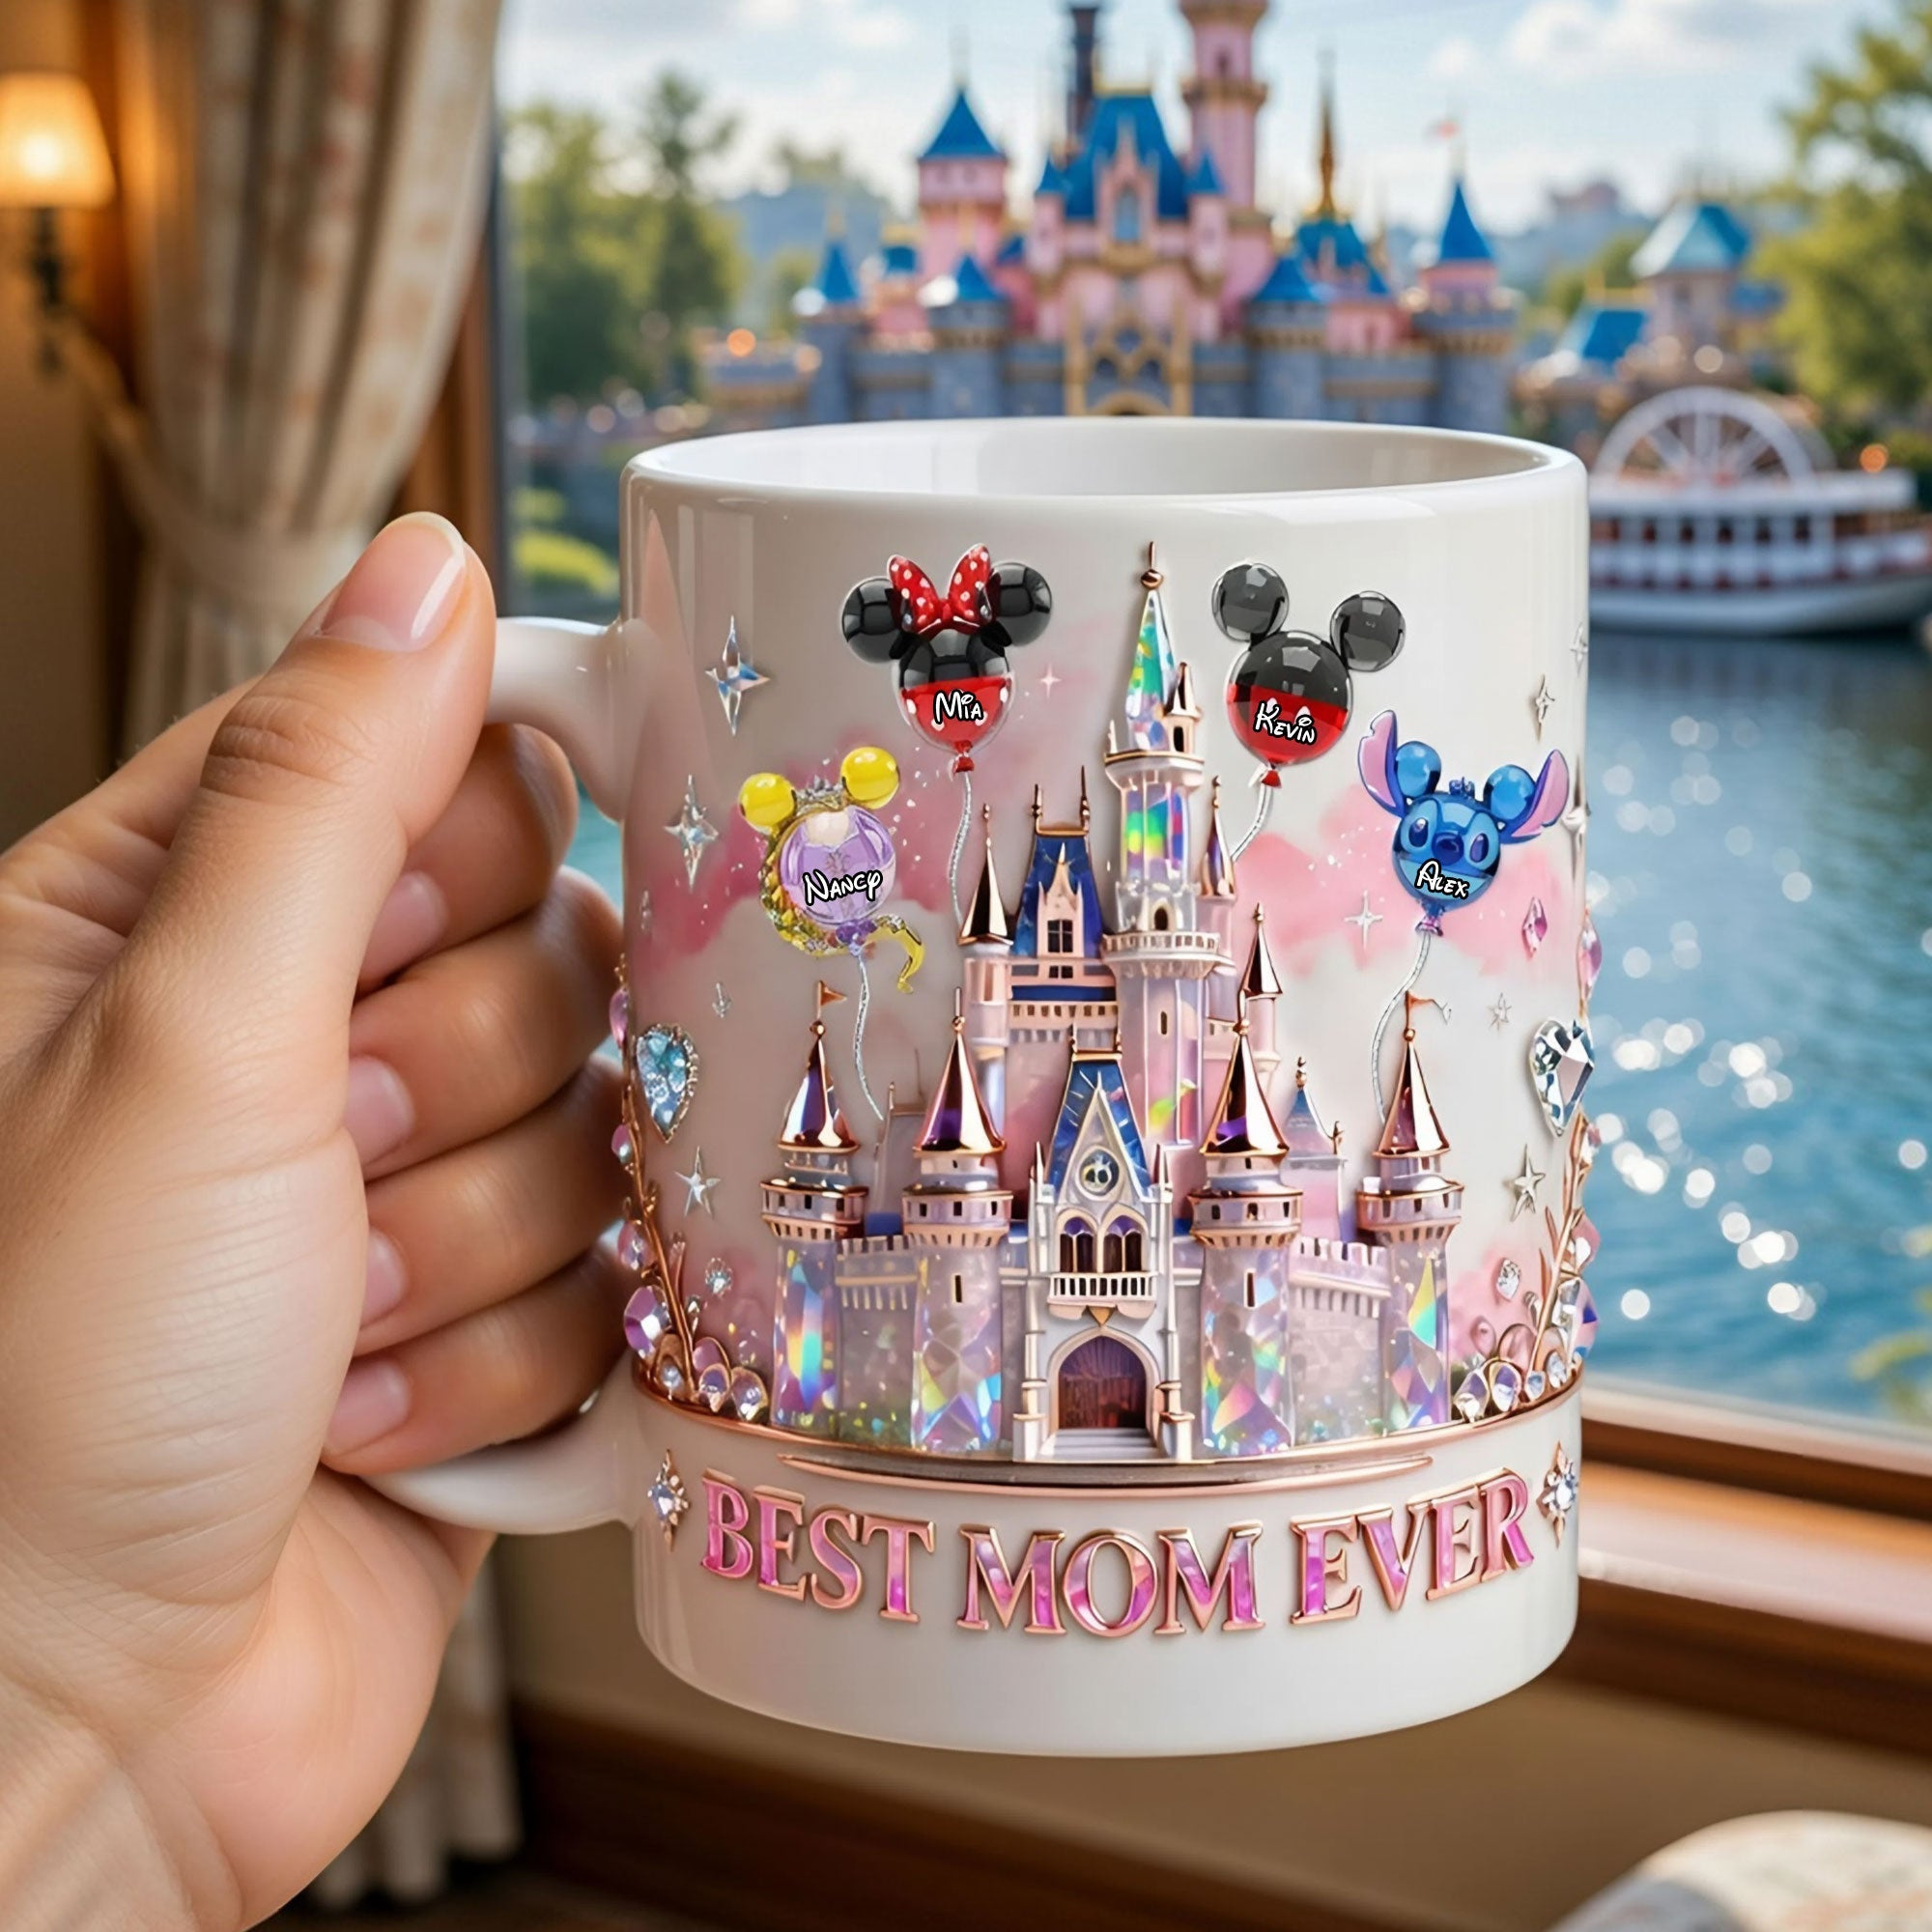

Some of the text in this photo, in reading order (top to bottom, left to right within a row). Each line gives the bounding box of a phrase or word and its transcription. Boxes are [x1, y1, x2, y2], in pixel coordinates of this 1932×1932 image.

[701, 1466, 1535, 1638] BEST MOM EVER
